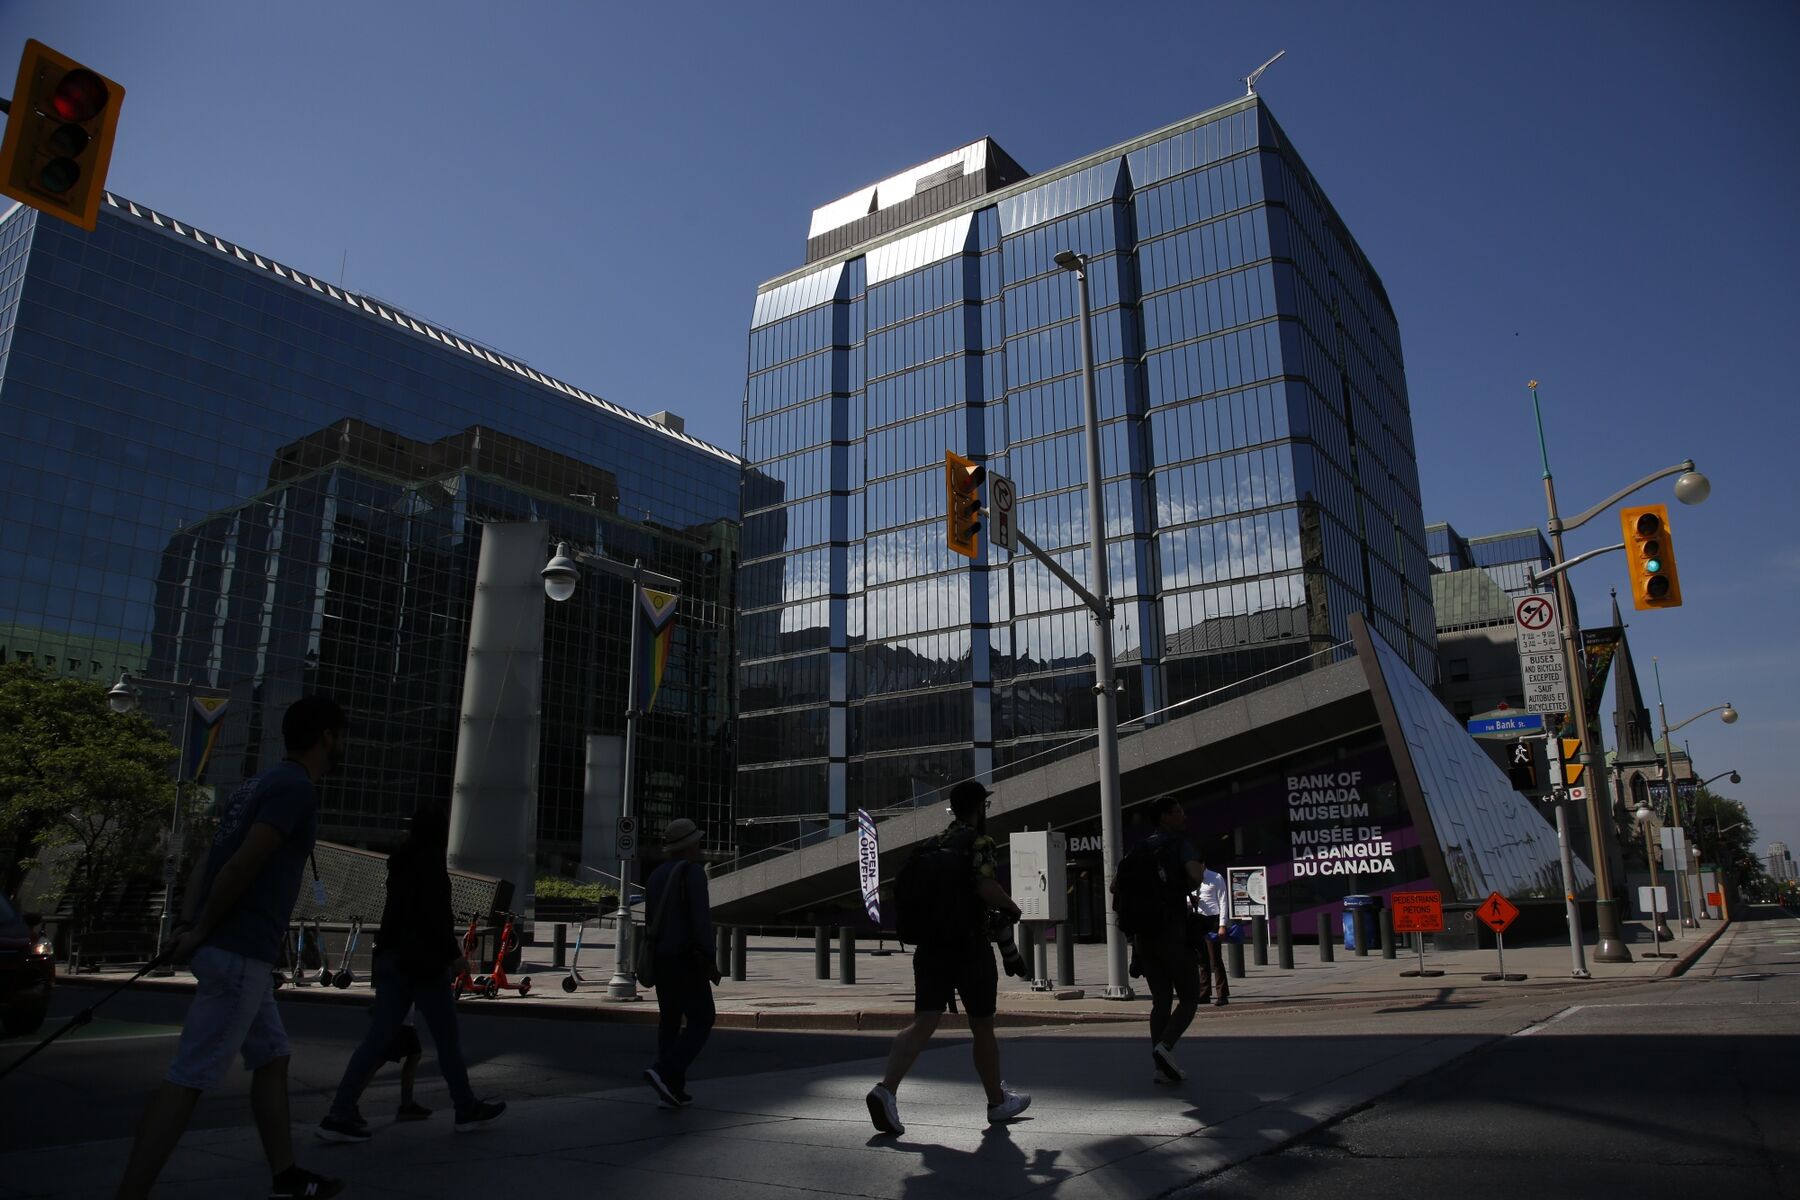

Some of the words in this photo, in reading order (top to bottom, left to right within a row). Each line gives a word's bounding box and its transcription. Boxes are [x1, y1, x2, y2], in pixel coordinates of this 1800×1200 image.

[1530, 655, 1555, 664] BUSES
[1525, 665, 1535, 674] AND
[1537, 663, 1562, 673] BICYCLES
[1529, 672, 1560, 683] EXCEPTED
[1537, 684, 1553, 693] SAUF
[1528, 693, 1556, 703] AUTOBUS
[1557, 692, 1565, 701] ET
[1528, 702, 1567, 712] BICYCLETTES
[1496, 719, 1516, 730] Bank
[1287, 773, 1335, 791] BANK
[1337, 771, 1361, 786] OF
[1287, 787, 1361, 806] CANADA
[1289, 803, 1368, 822] MUSEUM
[1291, 825, 1354, 845] MUSÉE
[1358, 826, 1382, 841] DE
[1292, 846, 1315, 861] LA
[1317, 842, 1393, 860] BANQUE
[868, 840, 876, 878] OPEN
[1293, 861, 1318, 877] DU
[1320, 858, 1395, 876] CANADA
[1393, 894, 1438, 904] PEDESTRIANS
